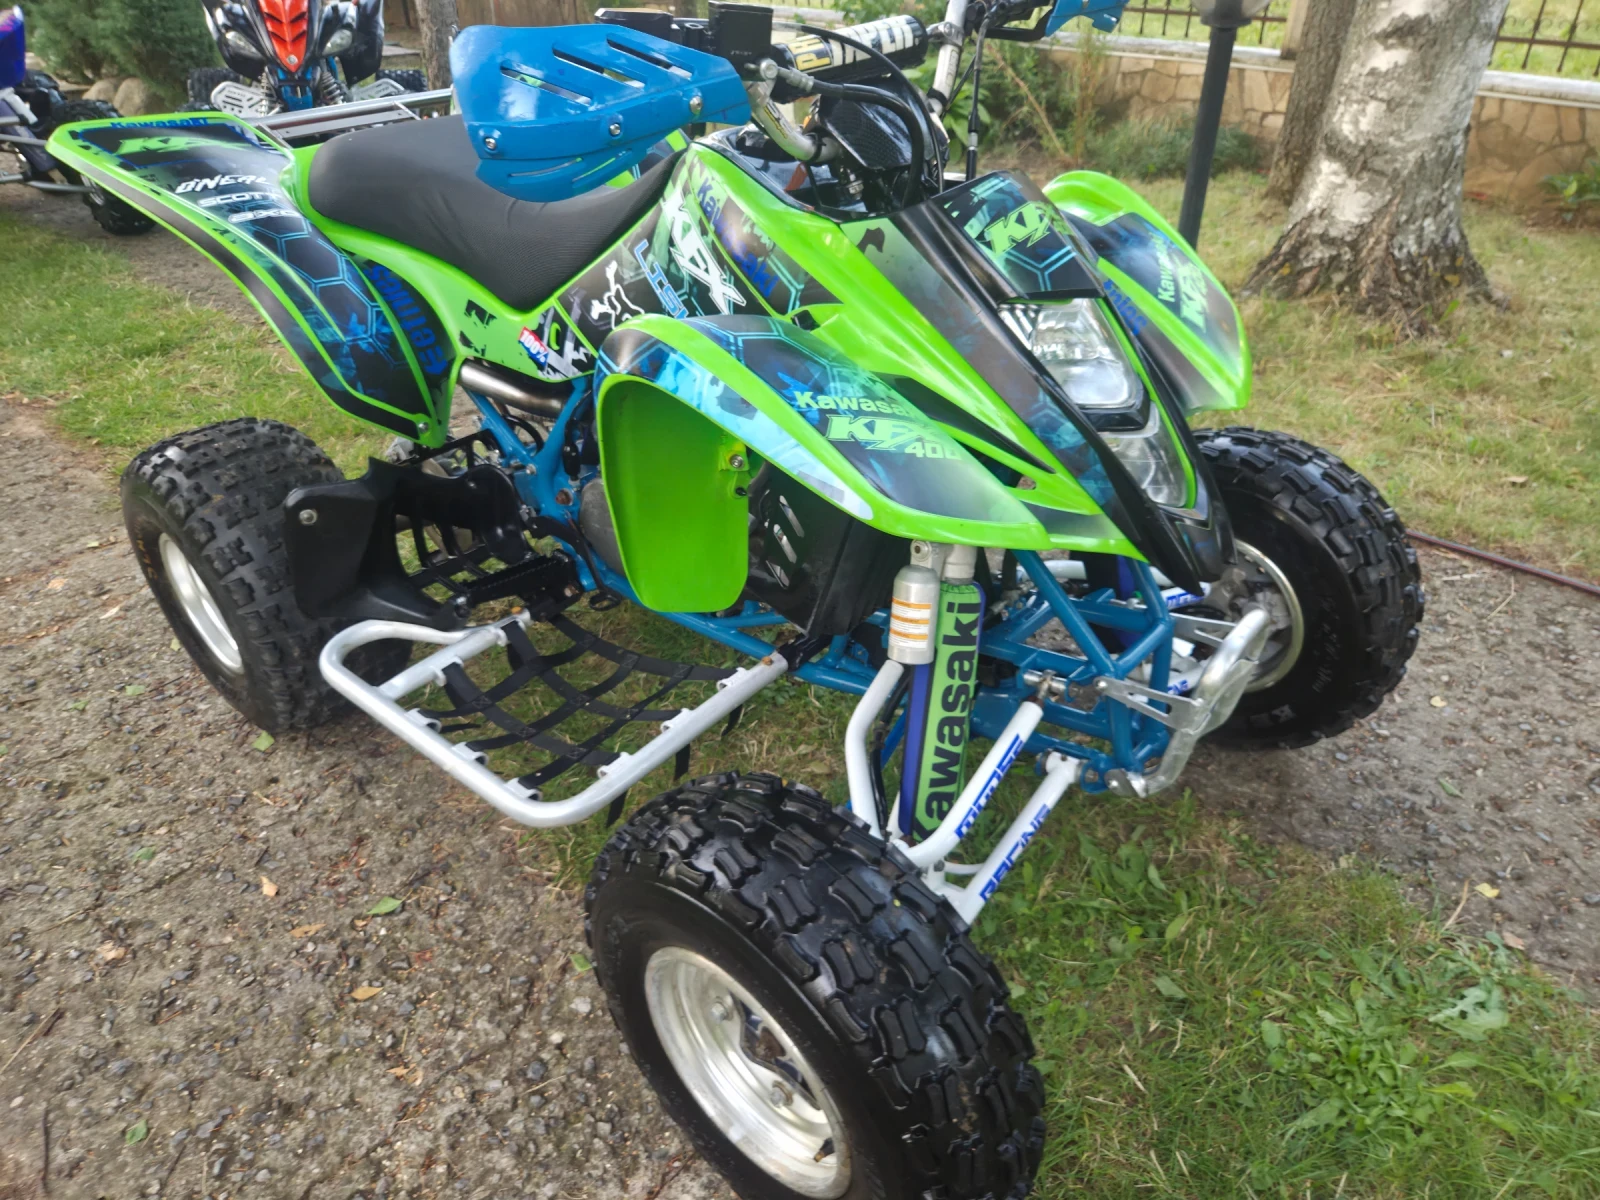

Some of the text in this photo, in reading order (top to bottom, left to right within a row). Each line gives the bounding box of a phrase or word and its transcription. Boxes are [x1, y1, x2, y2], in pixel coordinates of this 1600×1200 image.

[110, 116, 209, 129] Kawasaki
[519, 328, 548, 363] 100%
[793, 391, 912, 416] Kawasa
